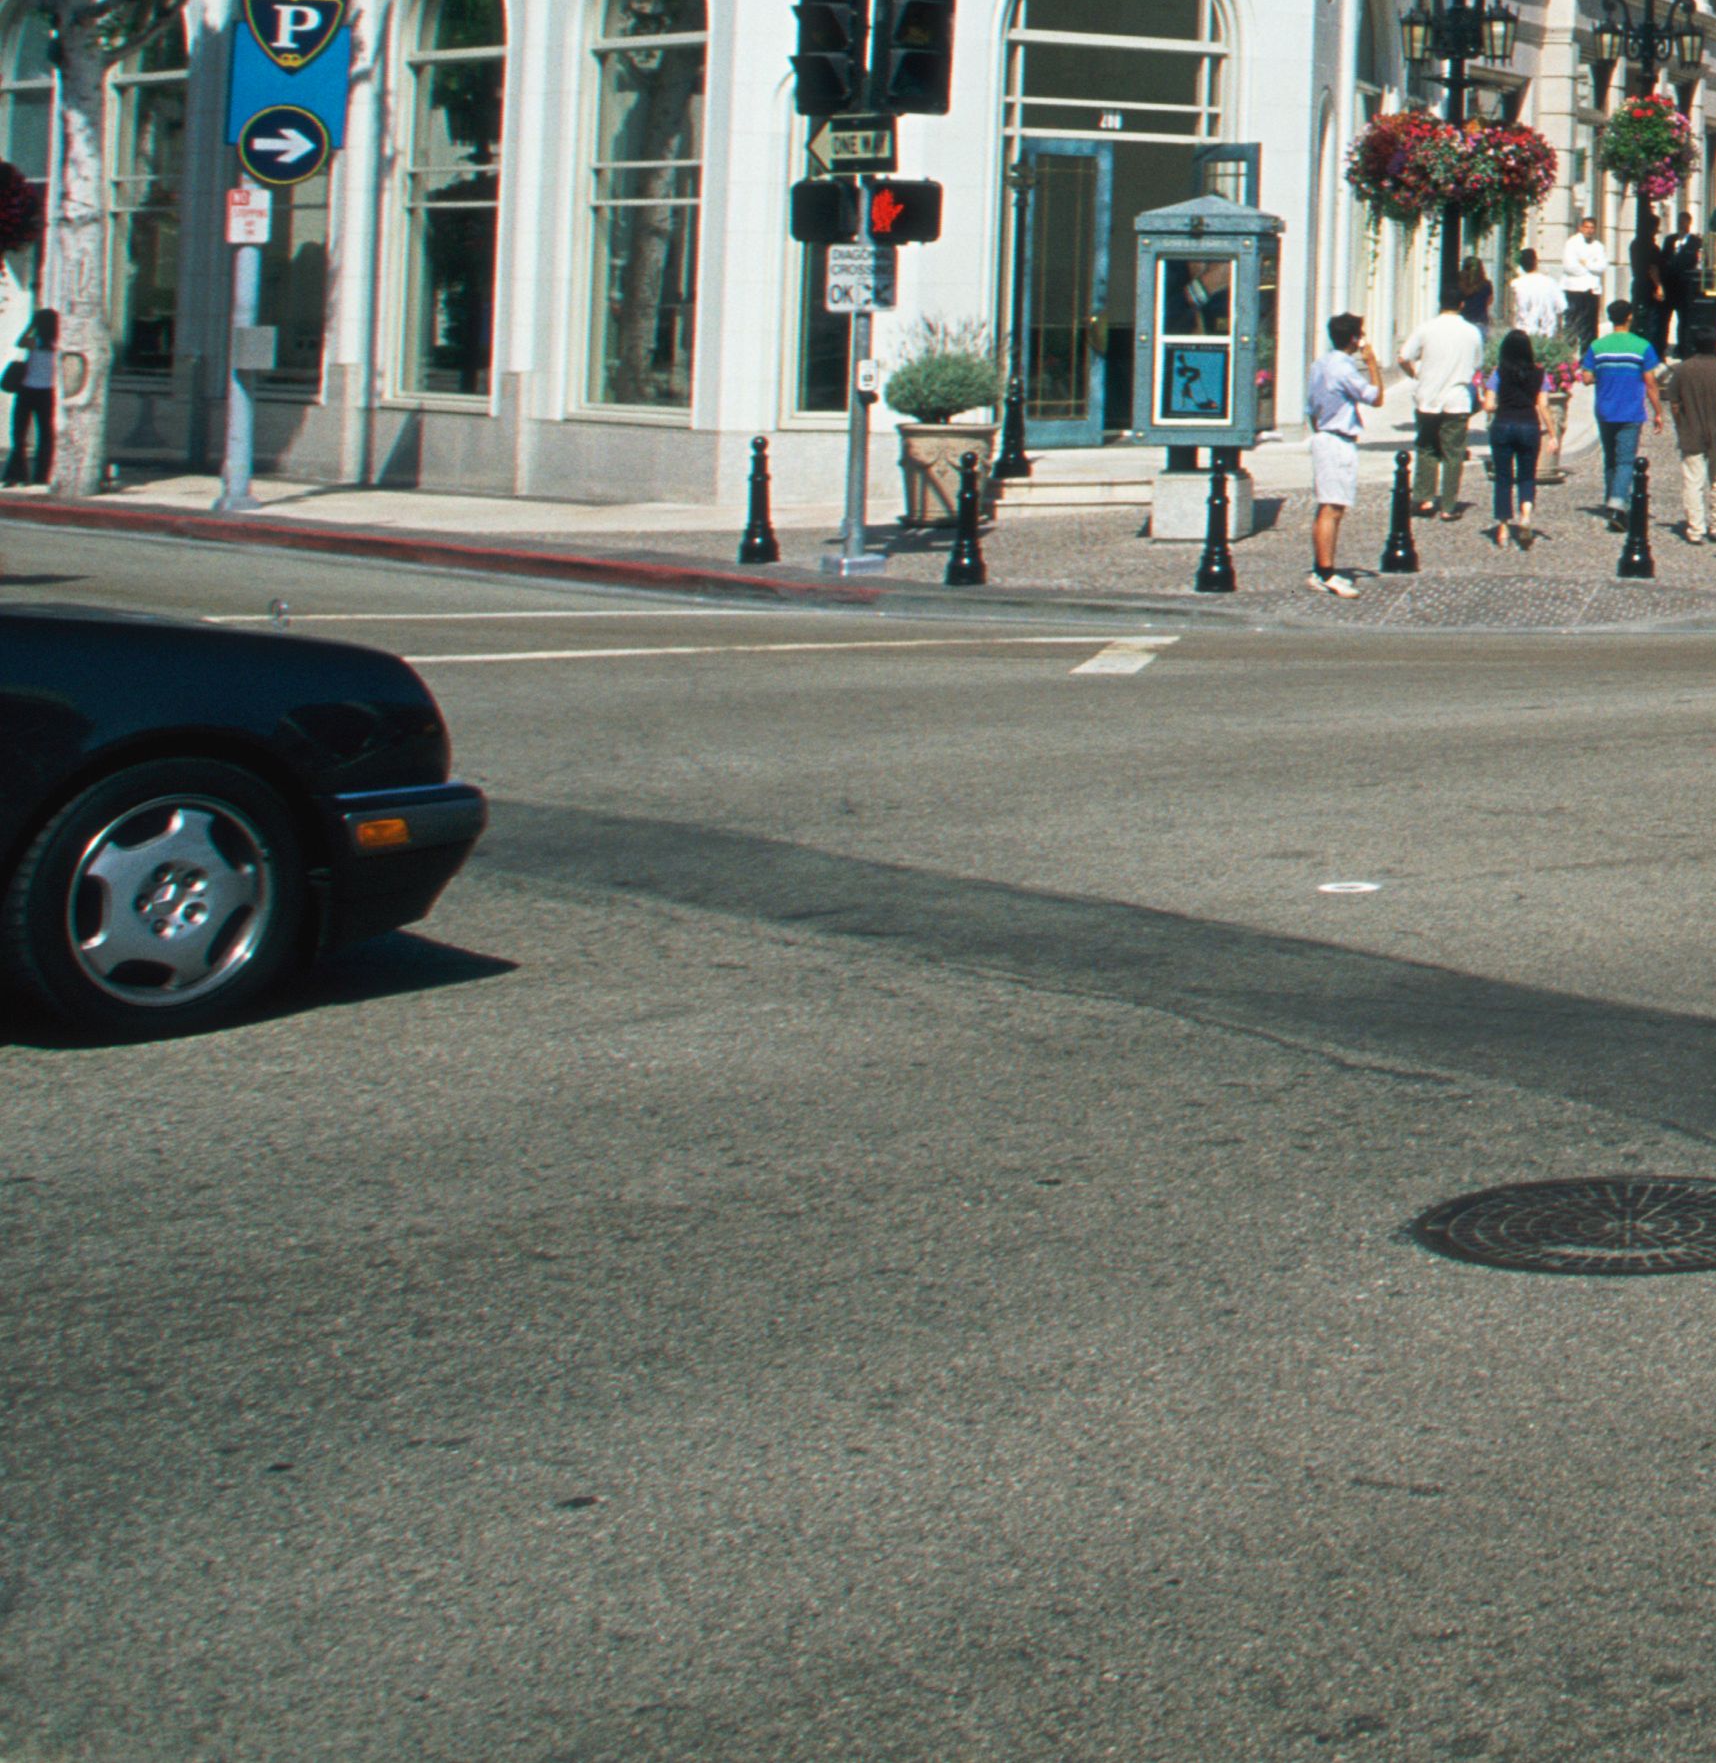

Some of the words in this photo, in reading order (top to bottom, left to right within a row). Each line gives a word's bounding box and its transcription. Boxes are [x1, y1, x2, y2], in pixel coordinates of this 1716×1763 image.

[269, 3, 322, 49] P
[832, 134, 858, 156] ONE
[829, 284, 855, 305] OK
